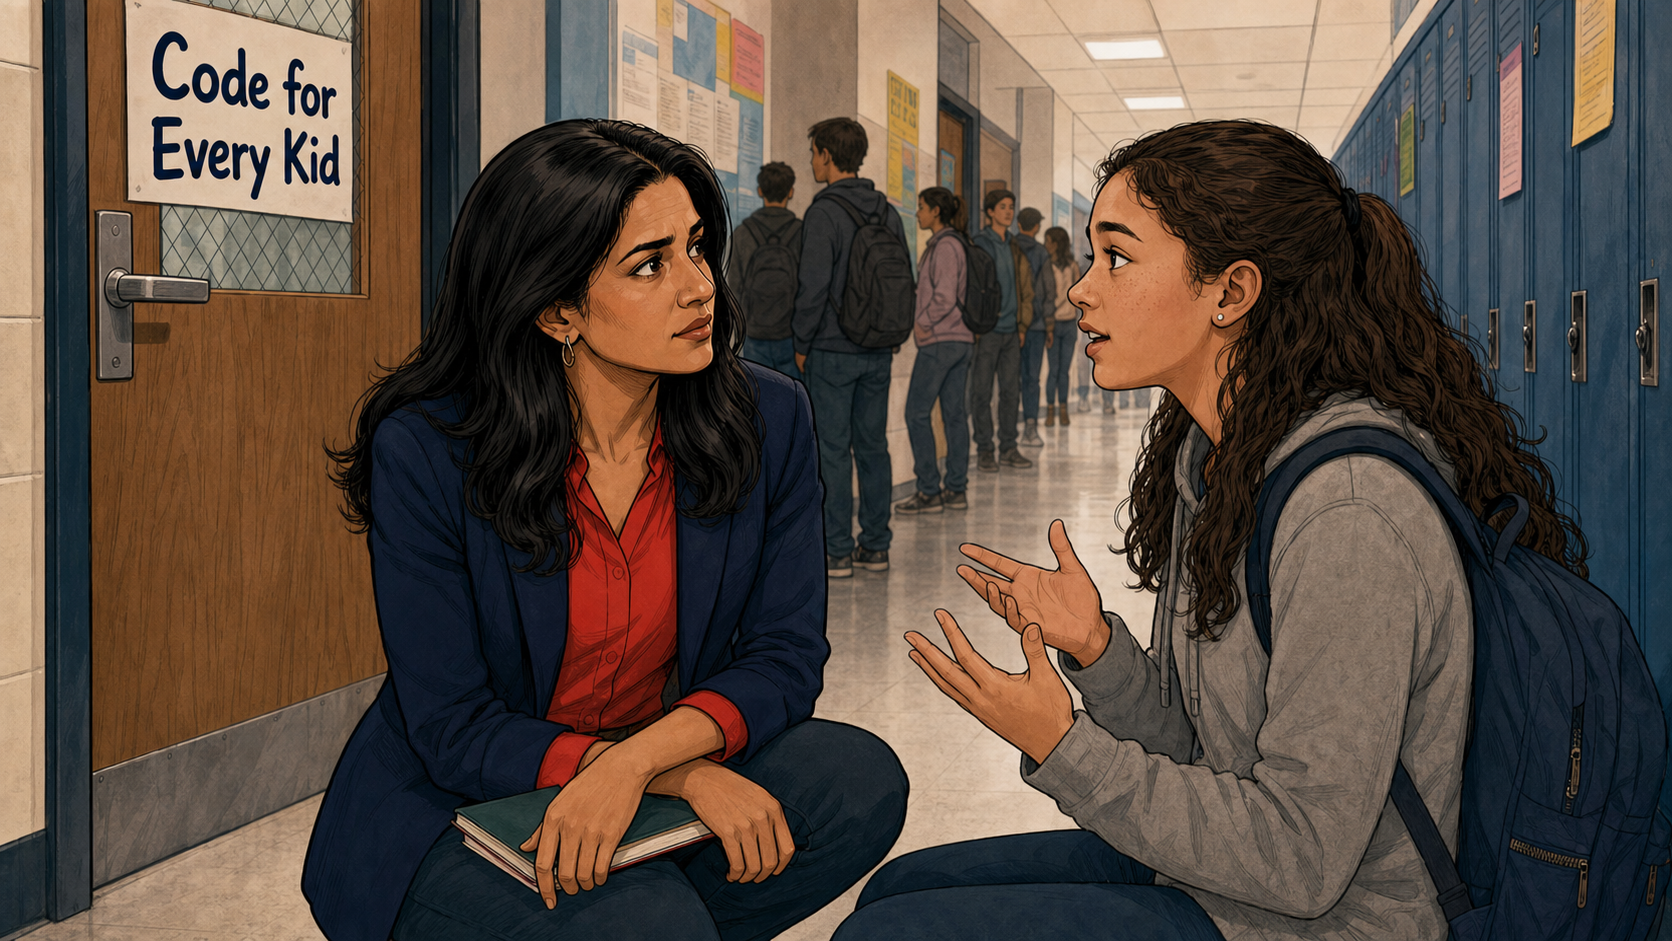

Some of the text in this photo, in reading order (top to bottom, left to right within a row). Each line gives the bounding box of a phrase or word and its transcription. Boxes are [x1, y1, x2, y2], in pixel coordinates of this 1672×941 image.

[152, 31, 337, 119] Code for
[151, 116, 341, 200] Every Kid
